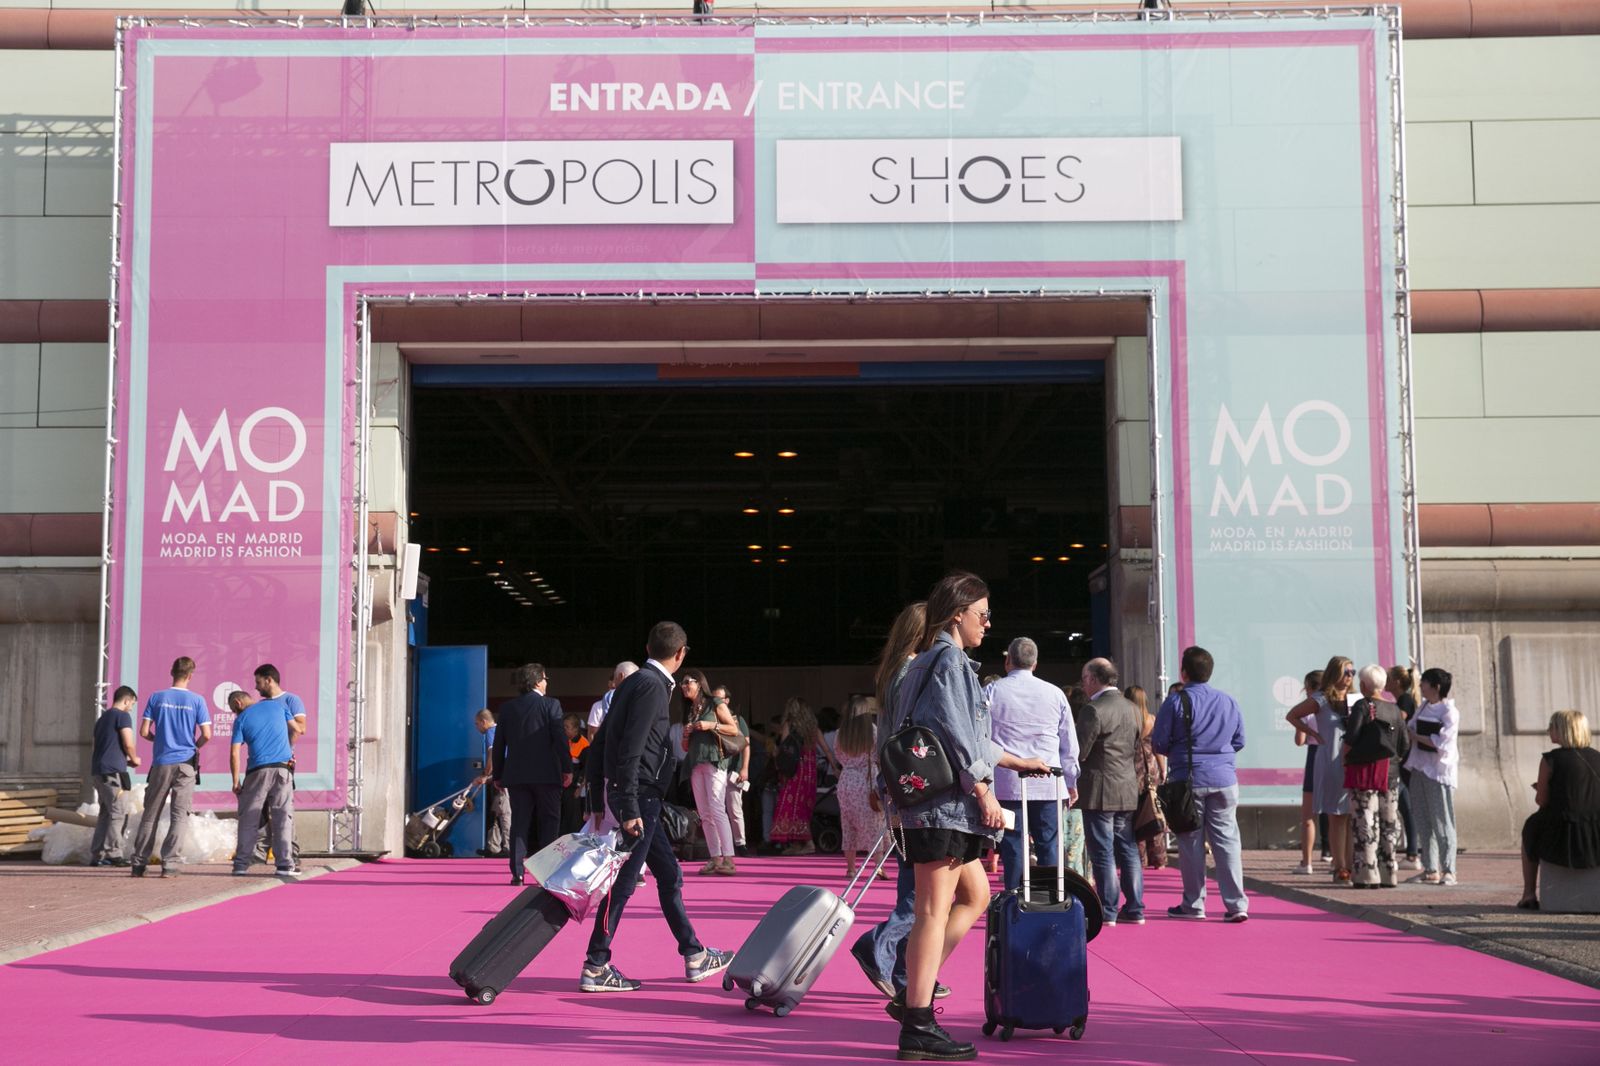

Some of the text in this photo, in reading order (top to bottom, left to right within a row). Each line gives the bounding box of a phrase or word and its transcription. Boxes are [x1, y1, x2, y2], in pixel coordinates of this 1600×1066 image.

[550, 80, 965, 117] ENTRADA / ENTRANCE
[346, 158, 717, 207] METROPOLIS
[869, 155, 1086, 204] SHOES
[163, 406, 307, 473] MO
[1209, 399, 1352, 467] MO
[162, 480, 305, 523] MAD
[1210, 473, 1353, 517] MAD
[160, 546, 302, 558] MADRID IS FASHION
[161, 532, 303, 545] MODA EN MADRID
[1209, 539, 1353, 552] MADRID IS FASHION
[1210, 526, 1353, 538] MODA EN MADRID
[214, 713, 236, 722] IFEM
